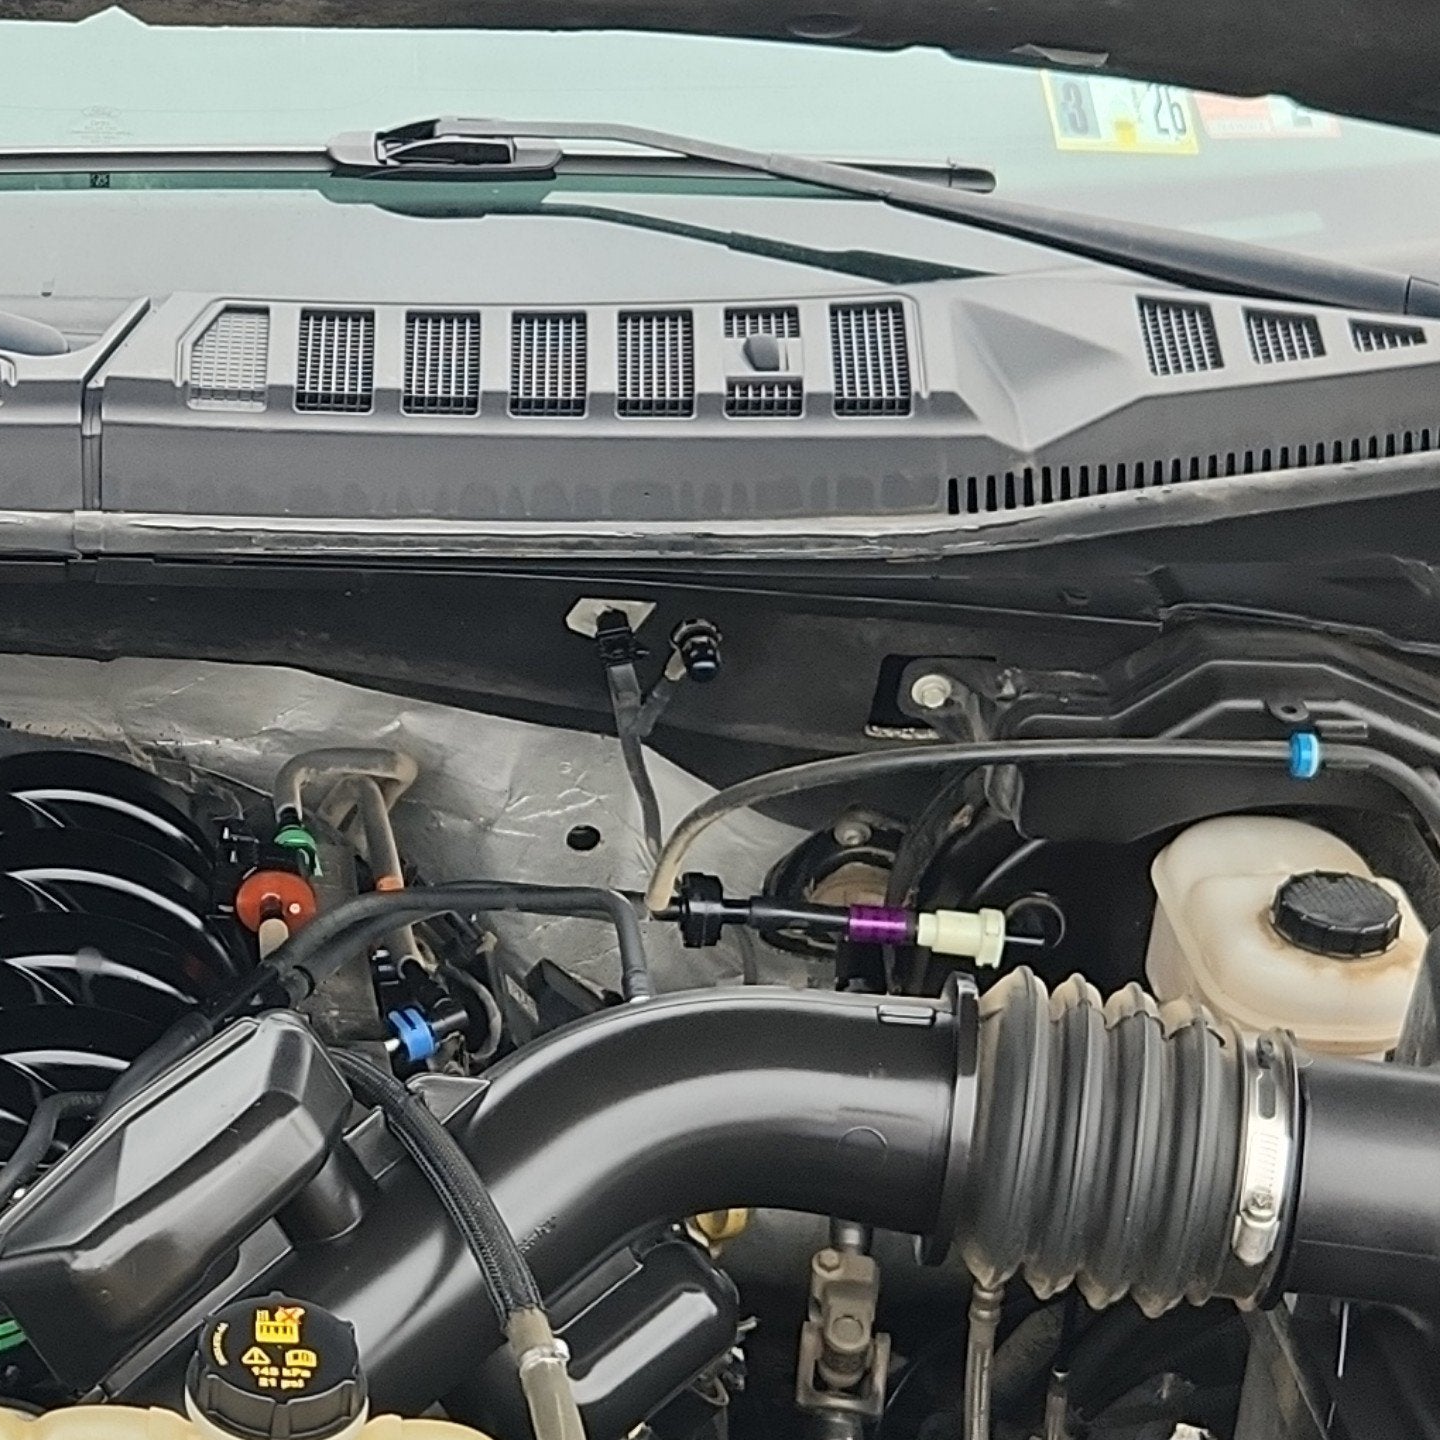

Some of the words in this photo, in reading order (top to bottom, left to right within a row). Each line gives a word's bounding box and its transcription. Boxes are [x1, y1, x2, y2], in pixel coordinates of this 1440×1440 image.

[1062, 80, 1089, 136] 3
[1146, 83, 1188, 136] 26
[282, 1367, 311, 1378] kPa
[281, 1379, 305, 1389] psi
